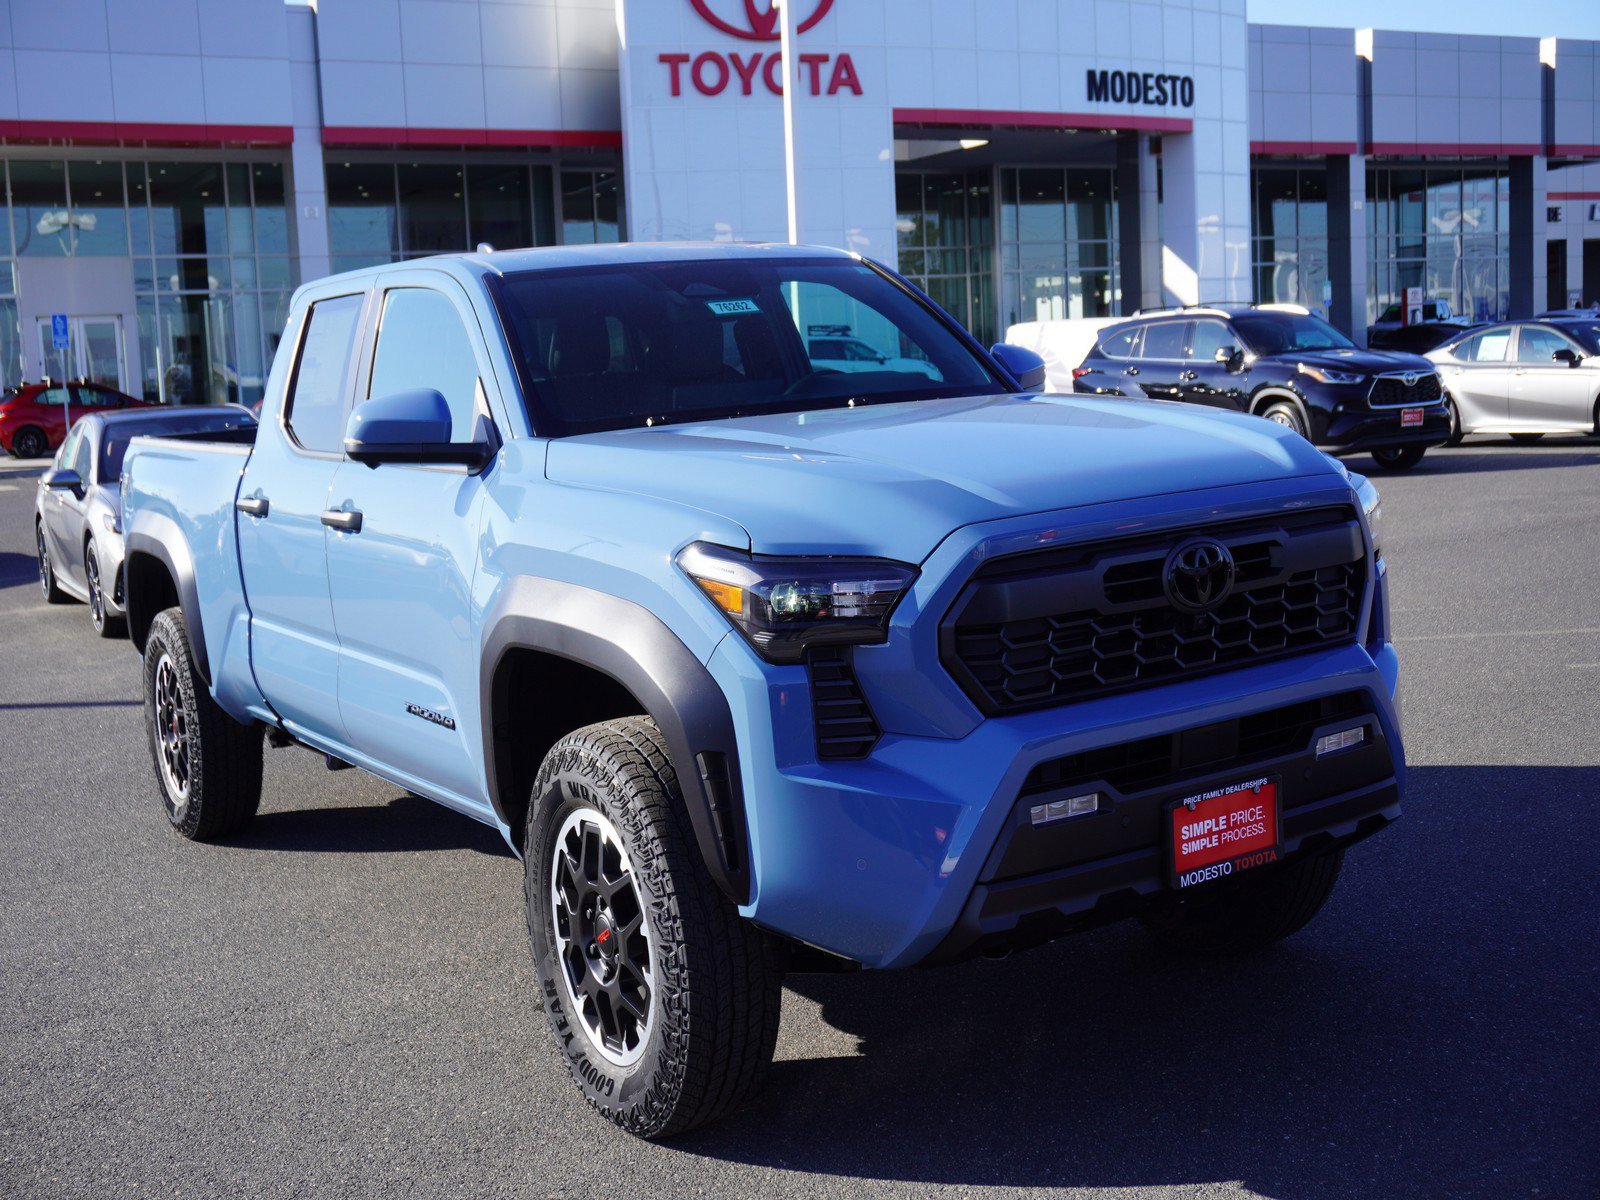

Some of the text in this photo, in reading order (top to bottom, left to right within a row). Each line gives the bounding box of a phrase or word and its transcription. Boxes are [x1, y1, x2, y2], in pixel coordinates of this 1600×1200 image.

[658, 51, 863, 96] TOYOTA
[1087, 69, 1195, 108] MODESTO
[715, 301, 751, 312] 76262
[1183, 777, 1268, 806] PRICE FAMILY DEALERSHIPS
[1181, 806, 1266, 840] SIMPLE PRICE.
[1181, 823, 1266, 855] SIMPLE PROCESS.
[1180, 850, 1277, 888] MODESTO TOYOTA
